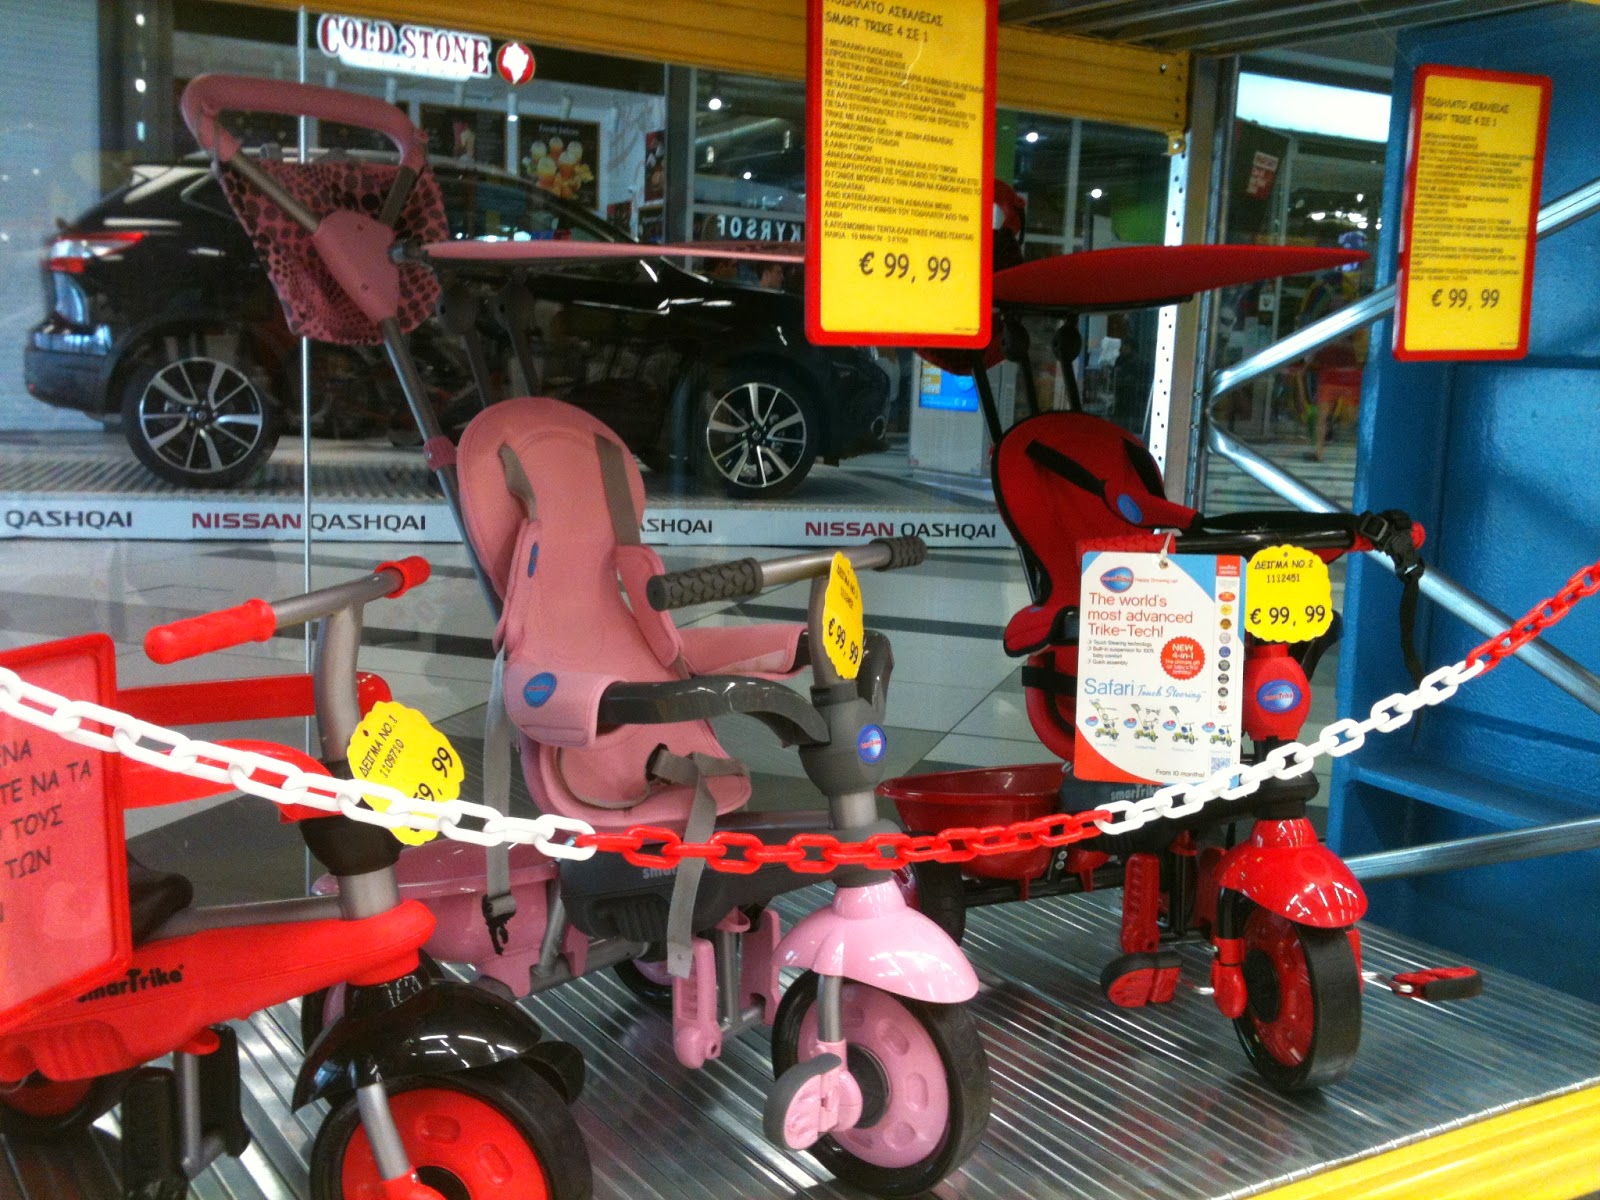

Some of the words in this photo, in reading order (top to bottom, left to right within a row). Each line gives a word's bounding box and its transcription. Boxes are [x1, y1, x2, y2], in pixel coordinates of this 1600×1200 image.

[825, 10, 860, 28] SMART
[864, 19, 893, 36] TRIKE
[897, 26, 903, 36] 4
[923, 30, 928, 42] 1
[321, 14, 394, 54] COLD
[401, 27, 489, 75] STONE
[859, 251, 874, 276] €
[927, 256, 952, 282] 99
[1431, 288, 1443, 307] €
[1481, 288, 1500, 309] 99
[5, 510, 133, 528] QASHQAI
[191, 512, 301, 529] NISSAN
[311, 513, 426, 532] QASHQAI
[805, 521, 894, 538] NISSAN
[901, 522, 996, 540] QASHQAI
[1254, 560, 1288, 570] ΔΕΙΓΜΑ
[1089, 592, 1115, 606] The
[1119, 594, 1167, 608] world's
[1088, 609, 1122, 622] most
[1126, 611, 1193, 623] advanced
[1249, 608, 1262, 625] €
[1305, 605, 1326, 623] 99
[1088, 622, 1164, 638] Trike-Tech!
[828, 618, 835, 637] €
[849, 640, 858, 664] 99
[1084, 677, 1135, 696] Safari
[1137, 684, 1163, 697] Touch
[0, 739, 32, 768] ΝΑ
[359, 740, 384, 778] ΔΕΙΓΜΑ
[431, 747, 453, 778] 99
[31, 770, 59, 796] ΝΑ
[67, 759, 92, 782] ΤΑ
[1110, 783, 1161, 801] smarTrik
[10, 803, 64, 839] ΤΟΥΣ
[4, 845, 52, 880] ΤΩΝ
